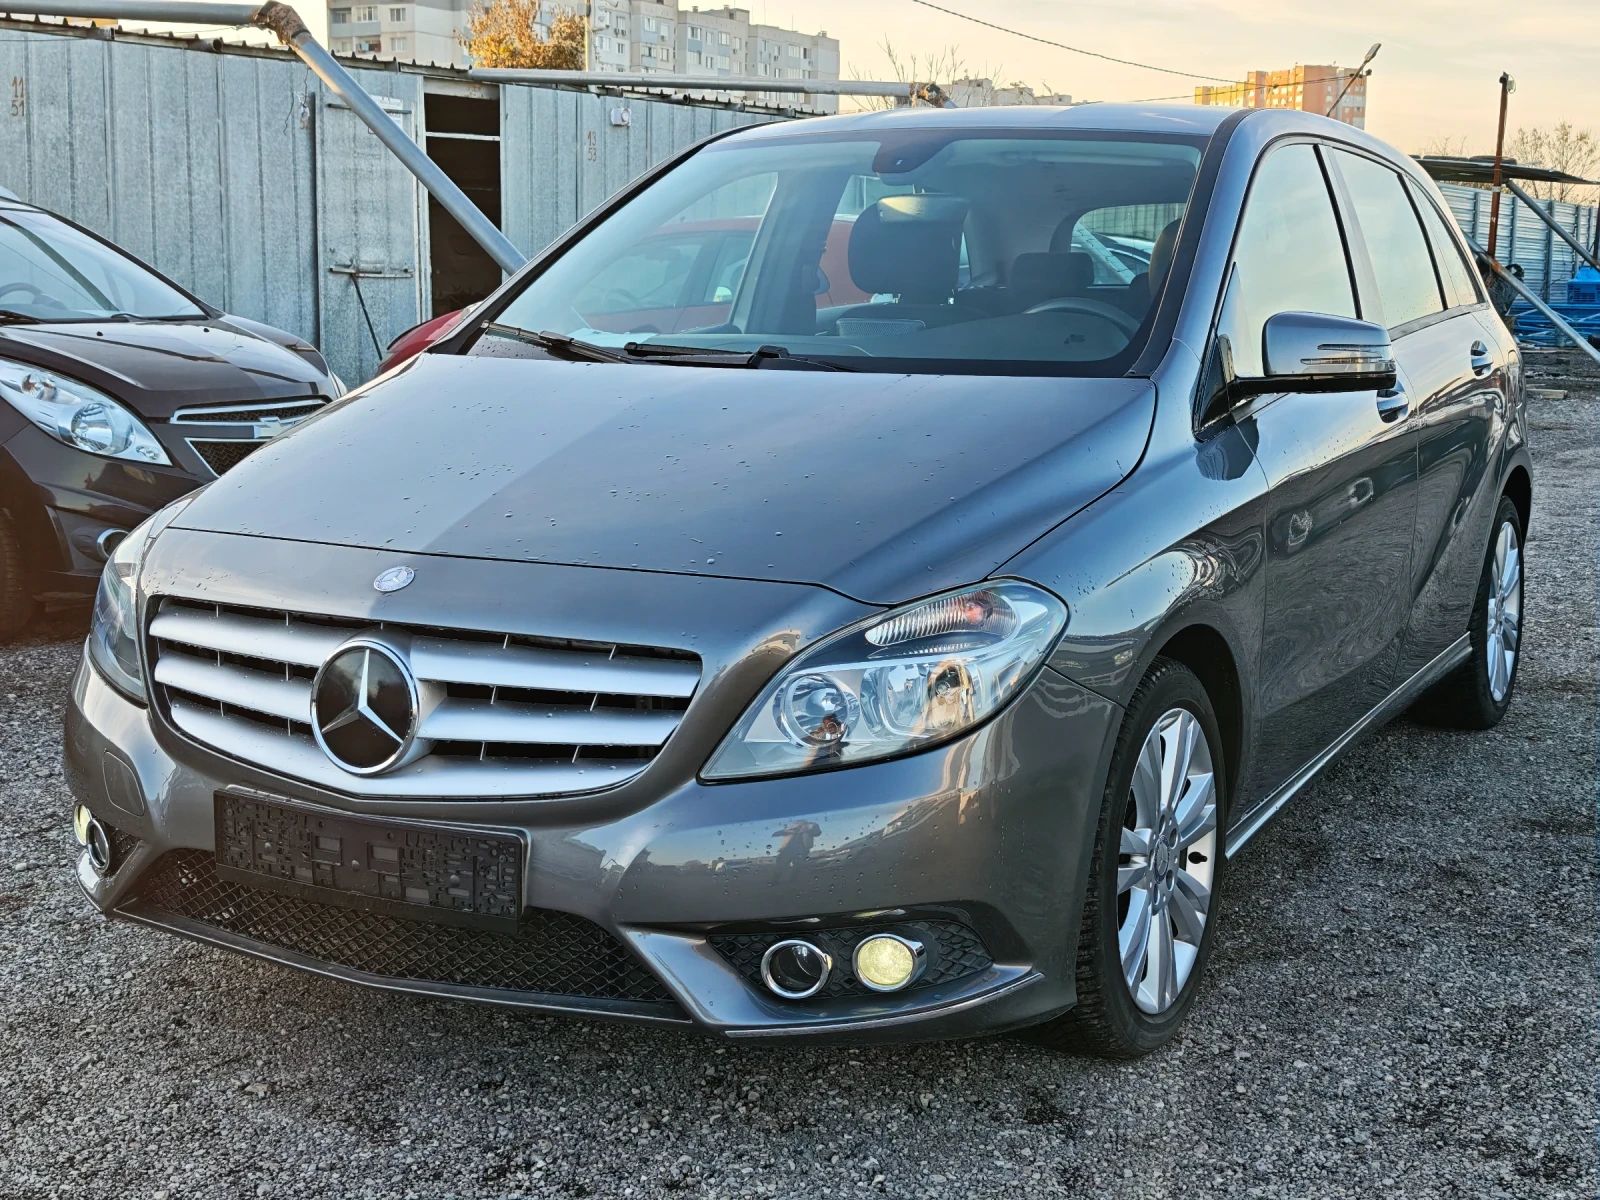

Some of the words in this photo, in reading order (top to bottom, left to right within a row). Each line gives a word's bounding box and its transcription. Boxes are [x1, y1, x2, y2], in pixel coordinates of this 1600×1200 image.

[12, 76, 24, 98] 11
[12, 99, 25, 117] 51
[587, 130, 597, 146] 13
[587, 147, 598, 162] 53
